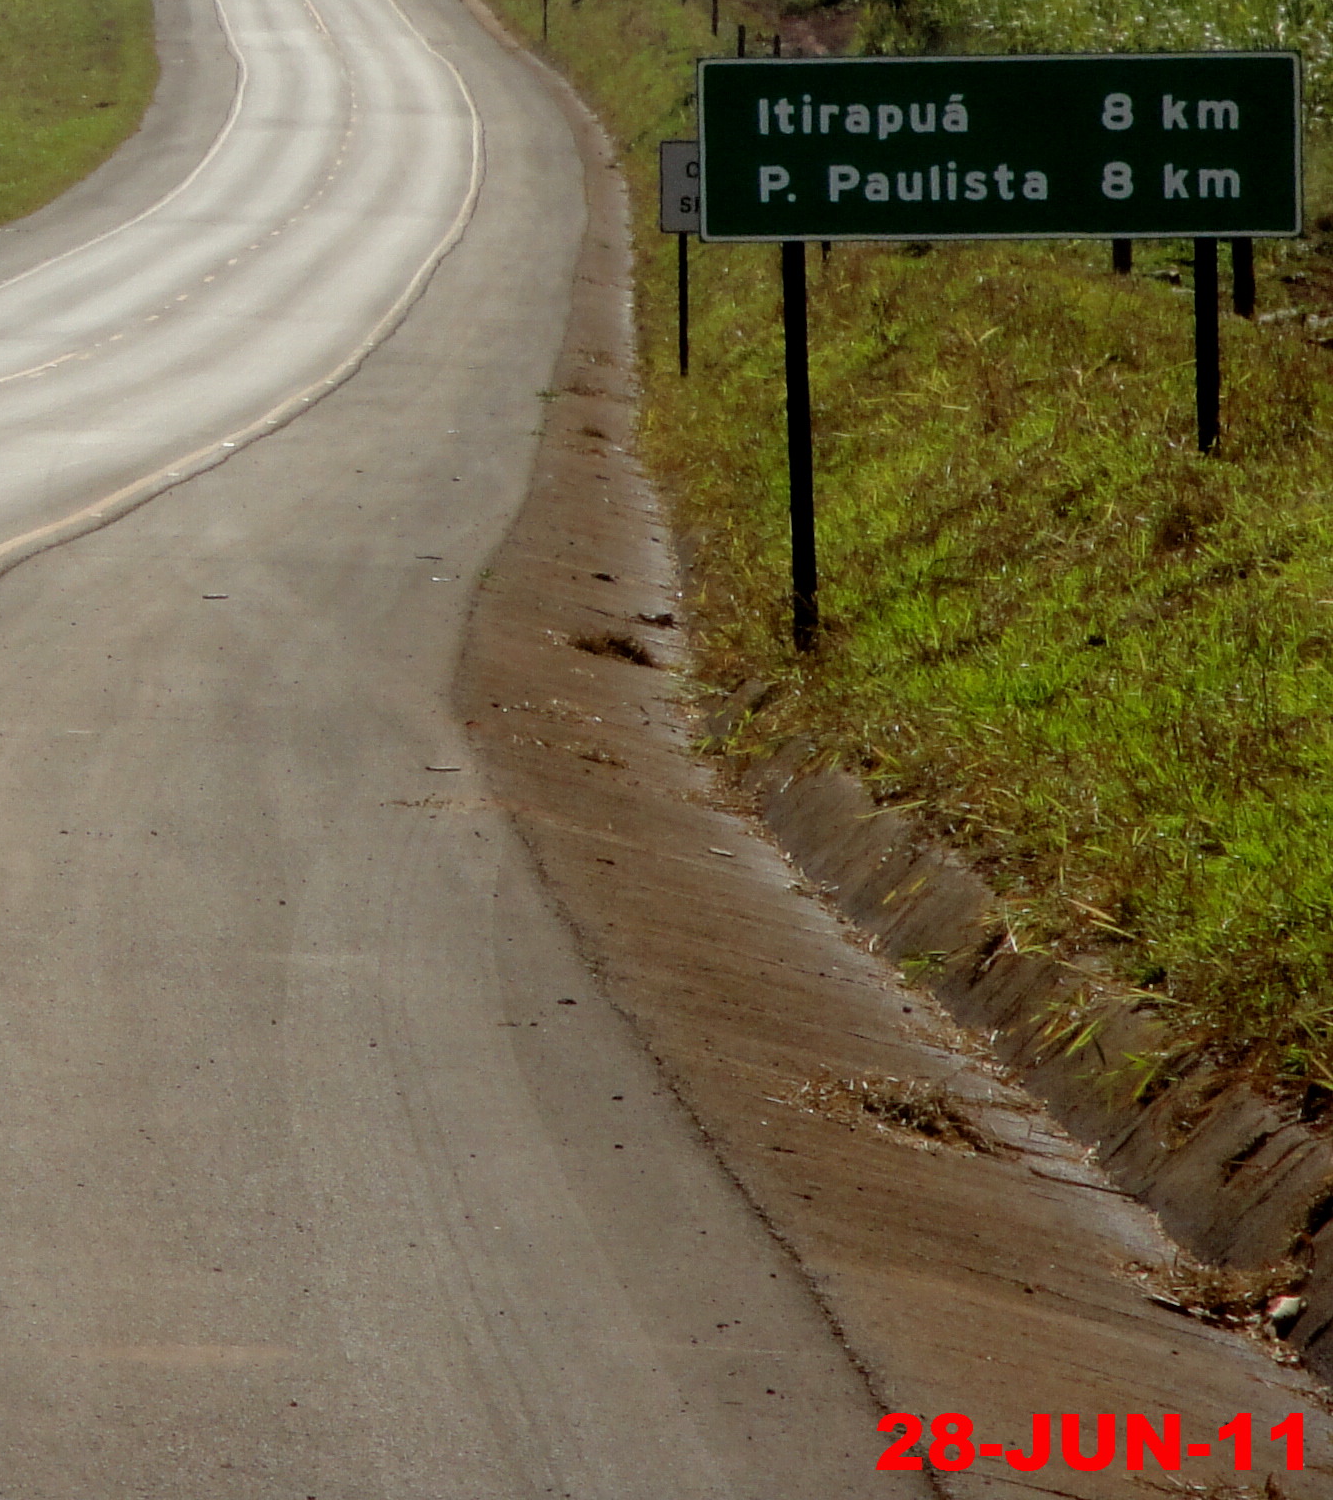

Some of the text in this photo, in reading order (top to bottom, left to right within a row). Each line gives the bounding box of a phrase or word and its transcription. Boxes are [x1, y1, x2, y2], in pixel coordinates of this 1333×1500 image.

[759, 92, 1240, 140] Itirapuá 8 km
[759, 161, 1241, 203] P. Paulista 8 km
